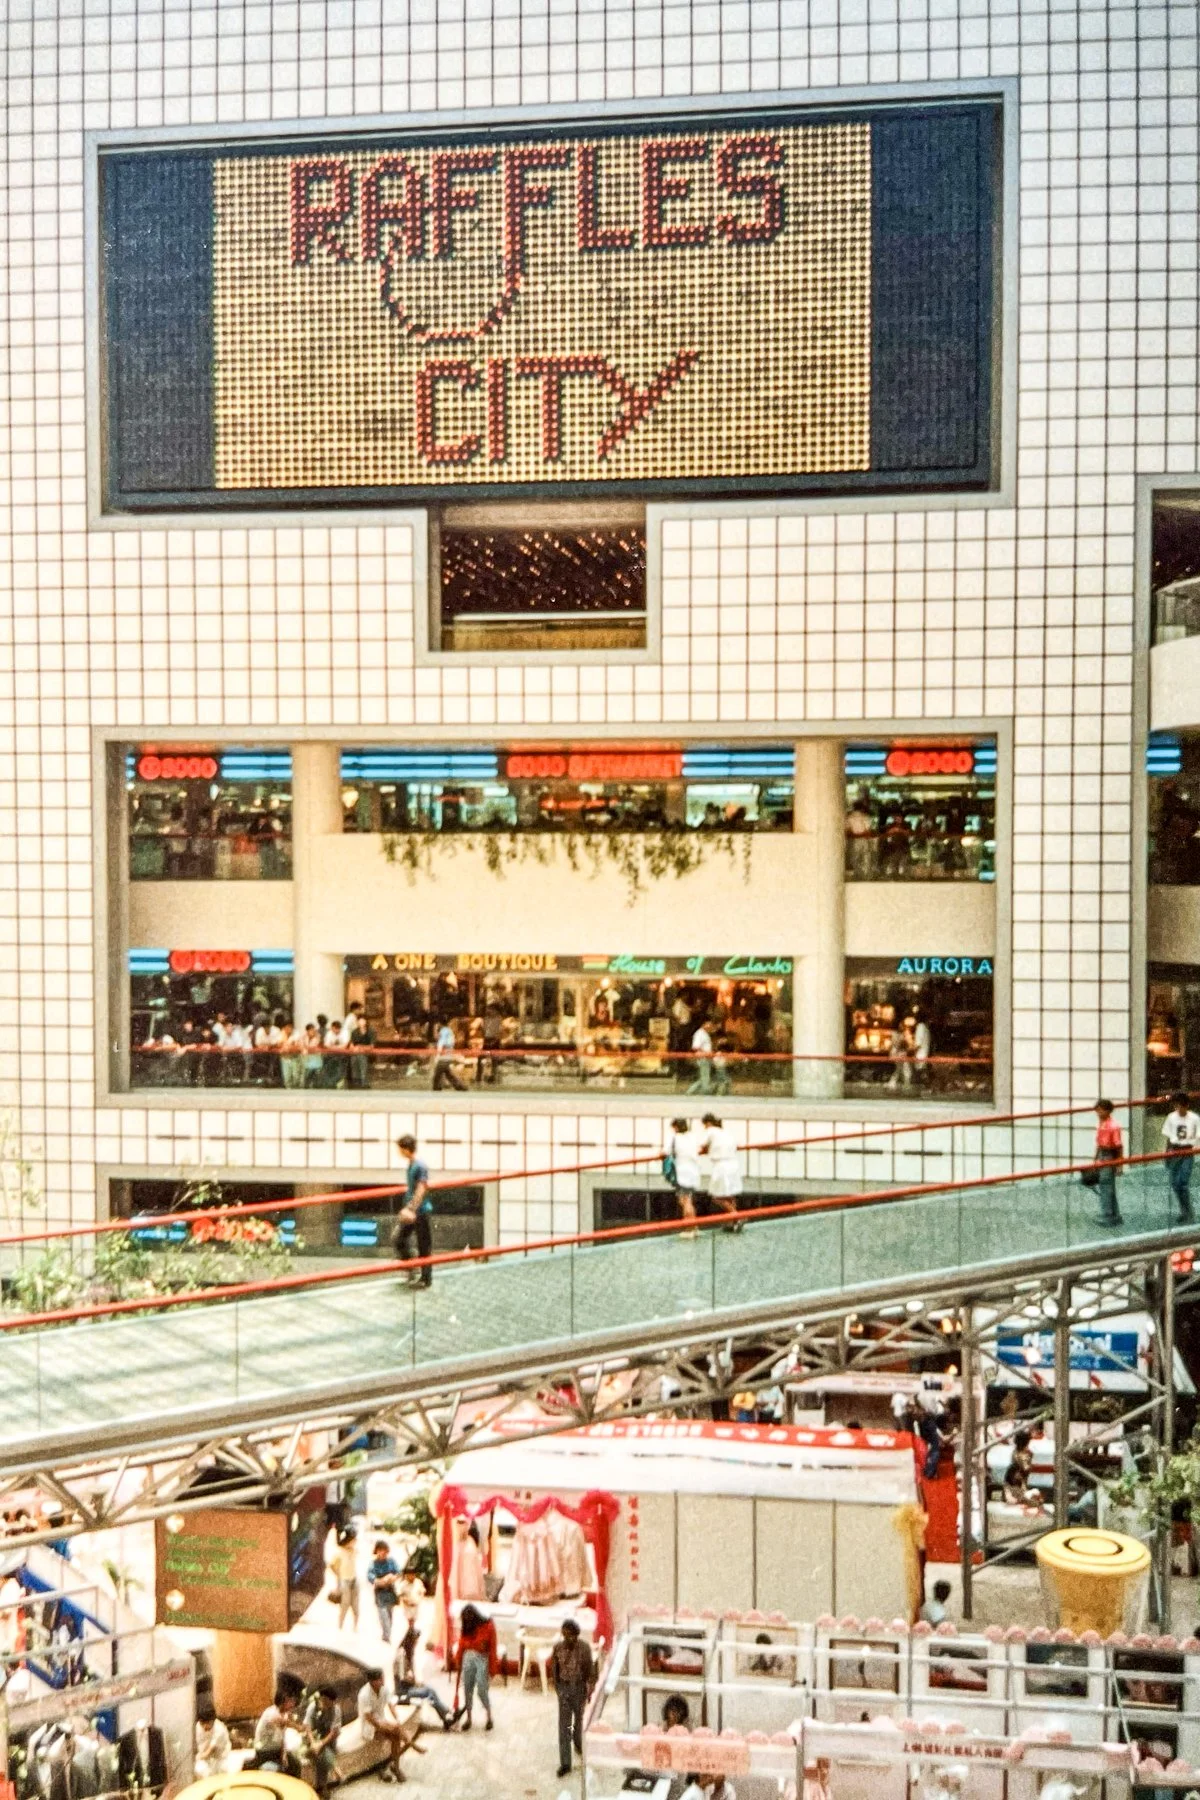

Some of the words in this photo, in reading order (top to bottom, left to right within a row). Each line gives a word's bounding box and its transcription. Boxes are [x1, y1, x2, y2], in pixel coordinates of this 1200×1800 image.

[291, 135, 786, 343] RAFFLES
[416, 348, 701, 467] CITY
[395, 953, 437, 970] ONE
[457, 953, 558, 970] BOUTIQUE
[686, 956, 705, 976] of
[897, 956, 993, 975] AURORA
